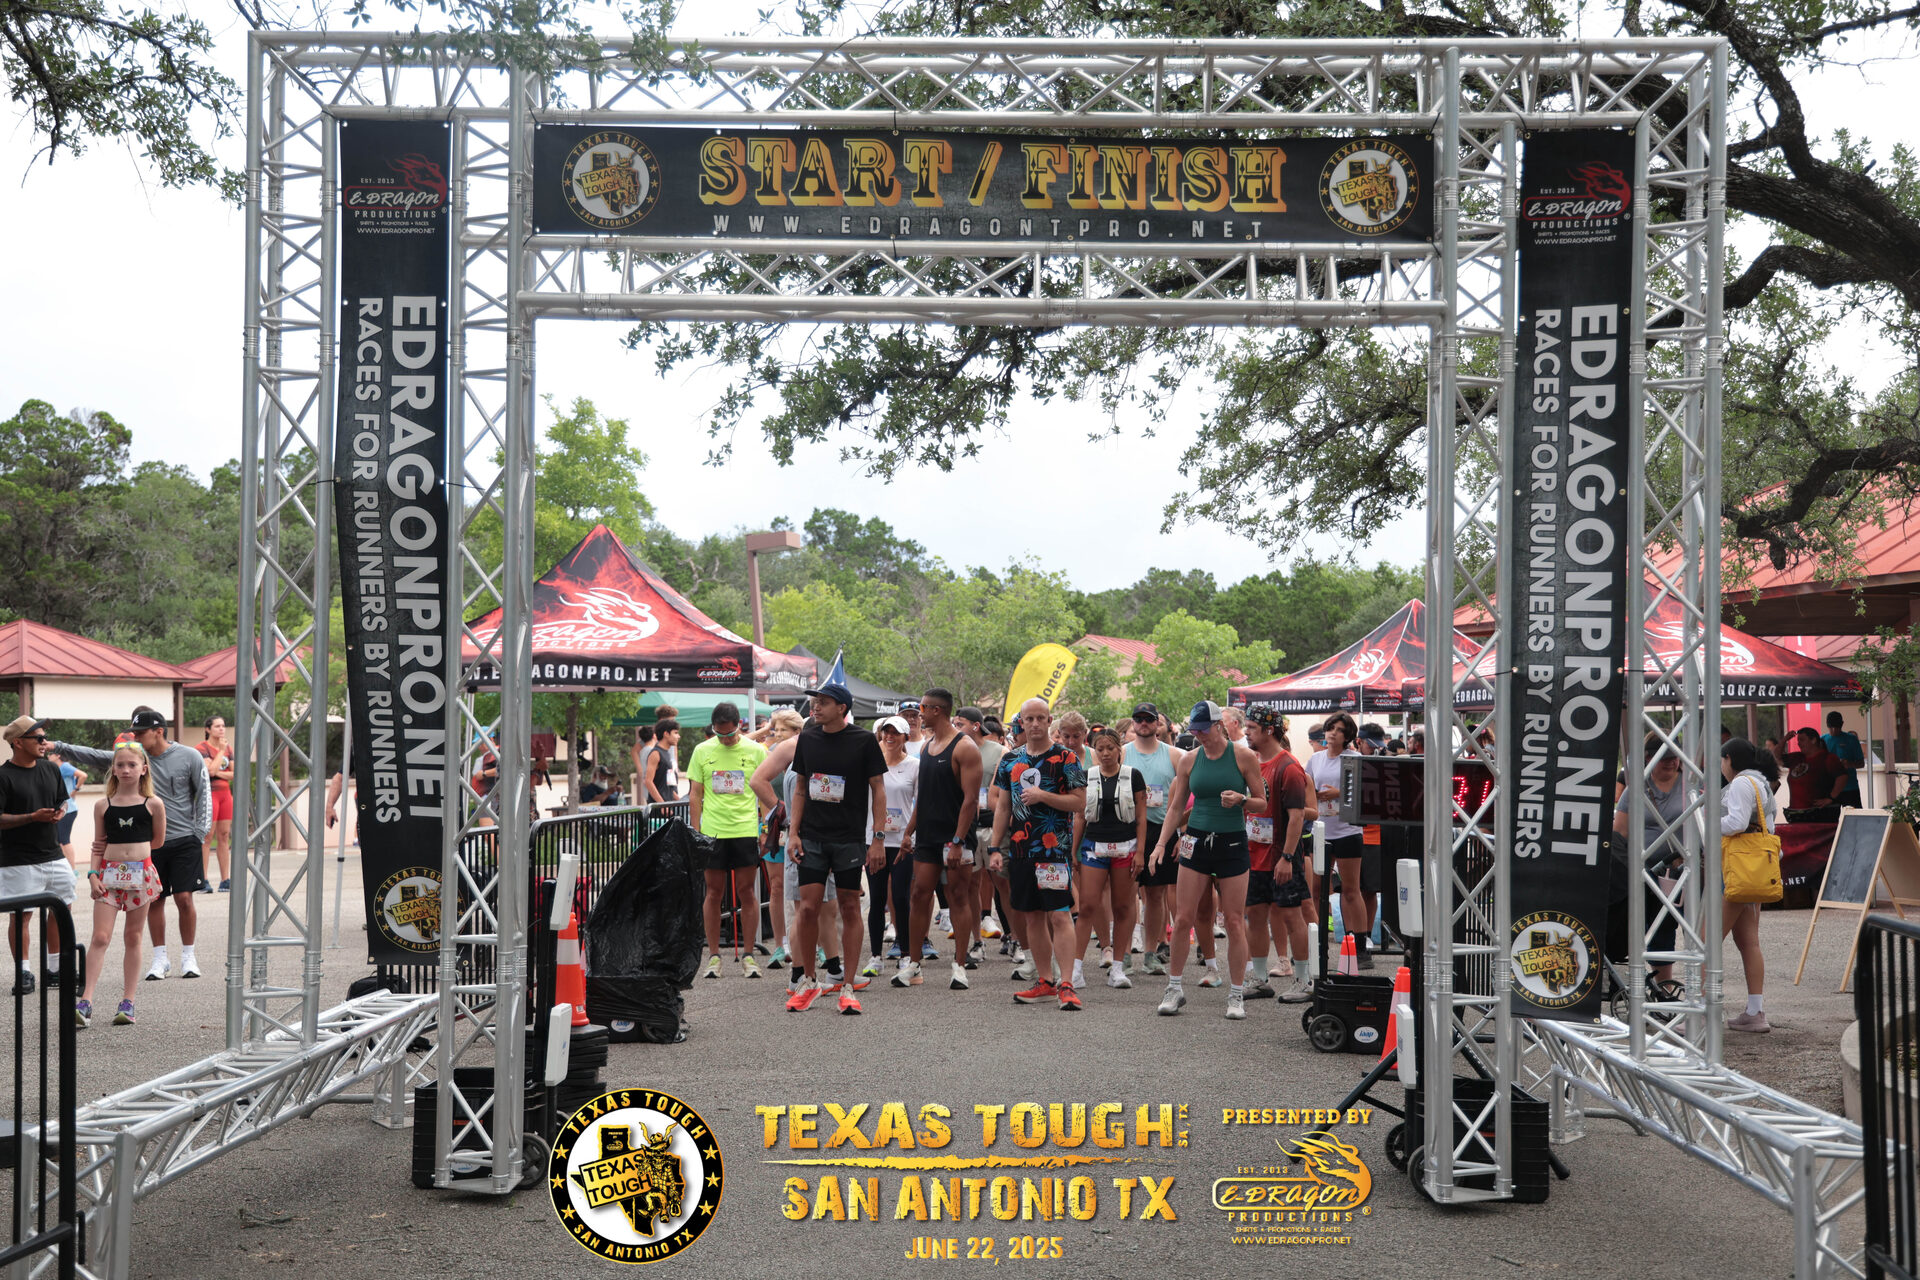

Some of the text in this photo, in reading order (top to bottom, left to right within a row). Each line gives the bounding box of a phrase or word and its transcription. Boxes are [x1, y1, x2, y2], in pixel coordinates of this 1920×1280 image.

[572, 133, 652, 162] TEXAS TOUGH
[1329, 141, 1409, 167] TEXAS TOUGH
[581, 167, 617, 183] TEXAS
[699, 136, 1288, 213] START / FINISH
[1339, 174, 1375, 192] TEXAS
[584, 181, 620, 195] TOUGH
[1341, 186, 1378, 203] TOUGH
[354, 210, 437, 218] PRODUCTIONS
[580, 209, 596, 222] SAN
[712, 214, 1263, 240] WWW.EDRAGONTPRO.NET
[1337, 217, 1354, 230] SAN
[1532, 218, 1619, 229] PRODUCTIONS
[352, 297, 402, 824] RACES FOR RUNNERS BY RUNNERS
[386, 295, 446, 819] EDRAGONPRO.NET
[1513, 309, 1562, 860] RACES FOR RUNNERS BY RUNNERS
[1550, 303, 1618, 866] EDRAGONPRO.NET
[1036, 661, 1067, 704] Jones
[115, 873, 132, 881] 128
[382, 868, 416, 890] TEXAS
[392, 899, 425, 914] TEXAS
[396, 909, 431, 923] TOUGH
[1511, 912, 1592, 942] TEXAS TOUGH
[1520, 946, 1556, 961] TEXAS
[1522, 959, 1559, 973] TOUGH
